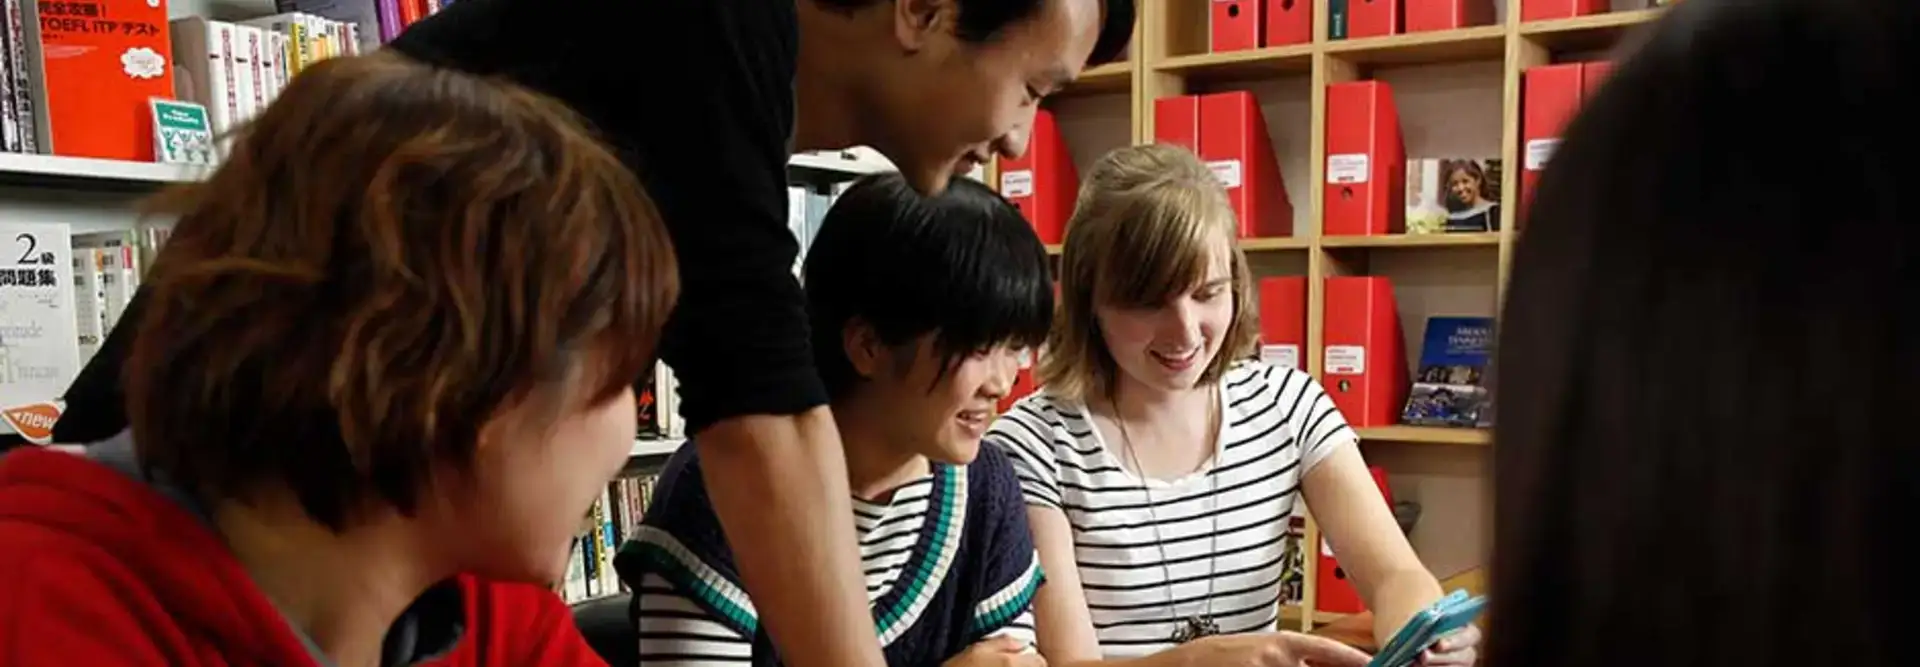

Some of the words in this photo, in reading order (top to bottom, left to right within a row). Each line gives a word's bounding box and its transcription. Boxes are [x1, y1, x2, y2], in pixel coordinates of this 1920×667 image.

[39, 16, 90, 33] TOEFL
[0, 268, 57, 287] 問題集
